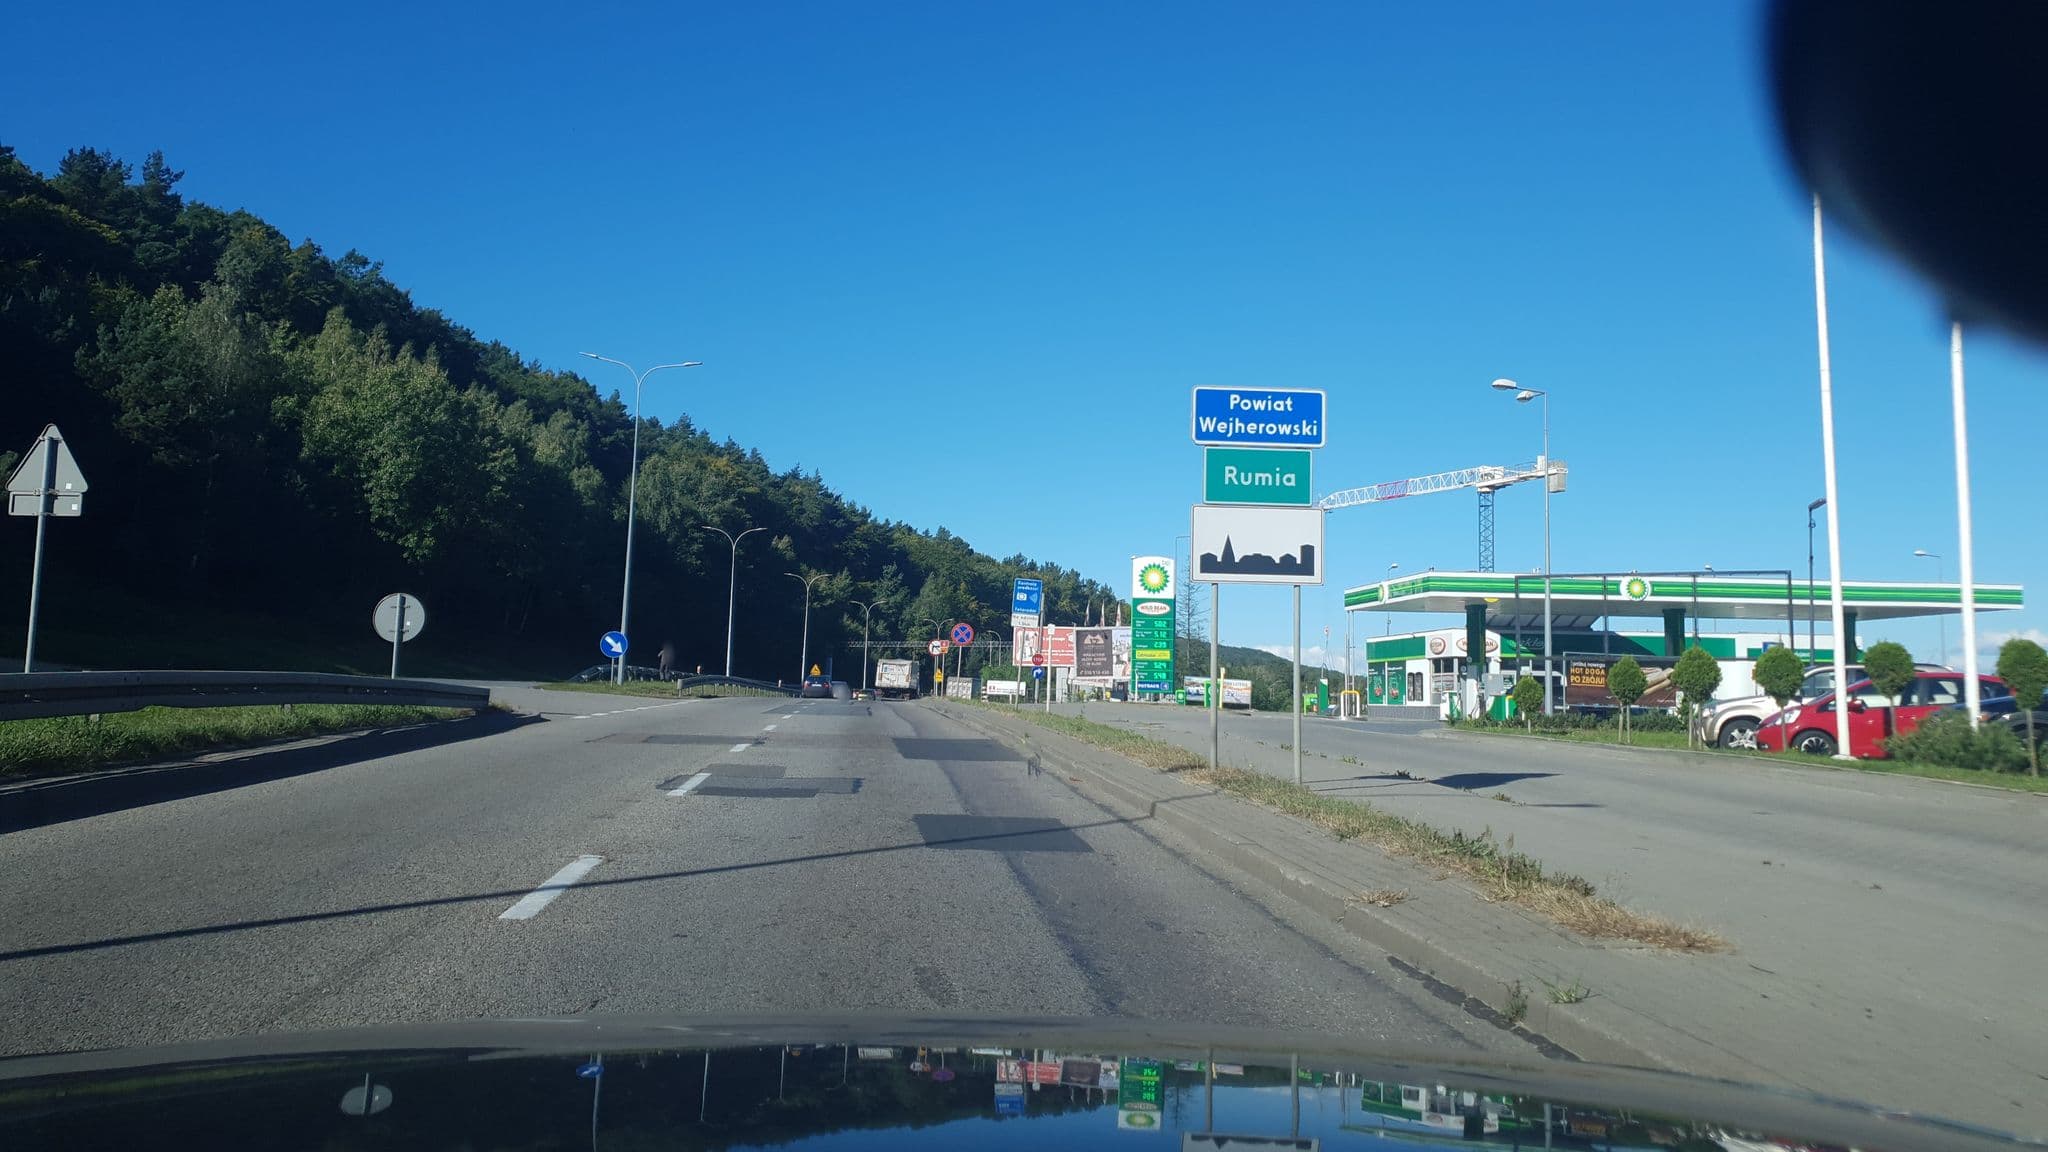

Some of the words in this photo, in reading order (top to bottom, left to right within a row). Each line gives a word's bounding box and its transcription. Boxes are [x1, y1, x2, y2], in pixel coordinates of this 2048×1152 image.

[1229, 394, 1293, 412] Powiat
[1199, 416, 1318, 437] Wejherowski
[1224, 465, 1296, 487] Rumia
